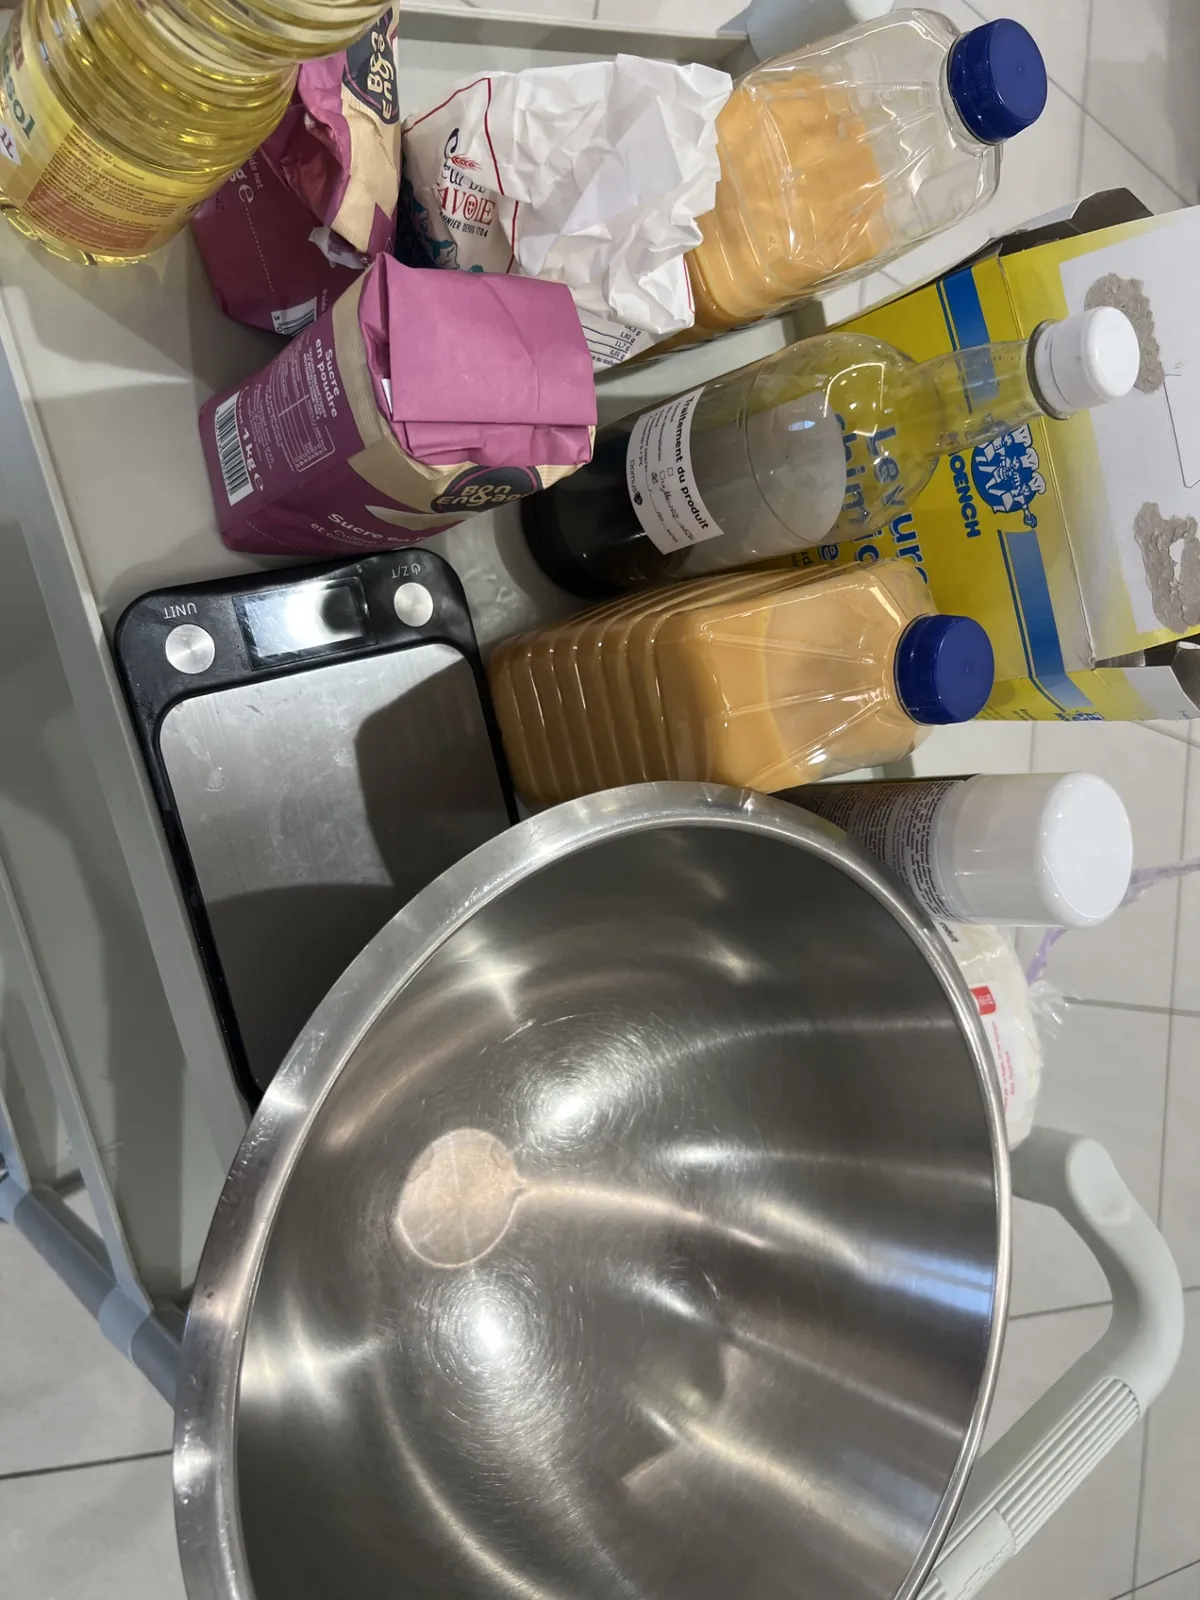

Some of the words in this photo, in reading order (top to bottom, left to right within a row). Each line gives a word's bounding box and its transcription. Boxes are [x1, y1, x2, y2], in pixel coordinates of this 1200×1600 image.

[437, 185, 496, 226] AVOIE
[315, 338, 323, 358] en
[325, 348, 340, 397] Sucre
[316, 361, 338, 418] poudre
[242, 427, 250, 441] 1
[676, 396, 695, 463] Traitement
[245, 442, 257, 472] kg
[676, 466, 686, 484] du
[680, 487, 710, 530] produit
[948, 453, 981, 538] OENCH
[310, 523, 326, 533] et
[327, 513, 384, 539] Sucre
[163, 602, 198, 620] UNIT
